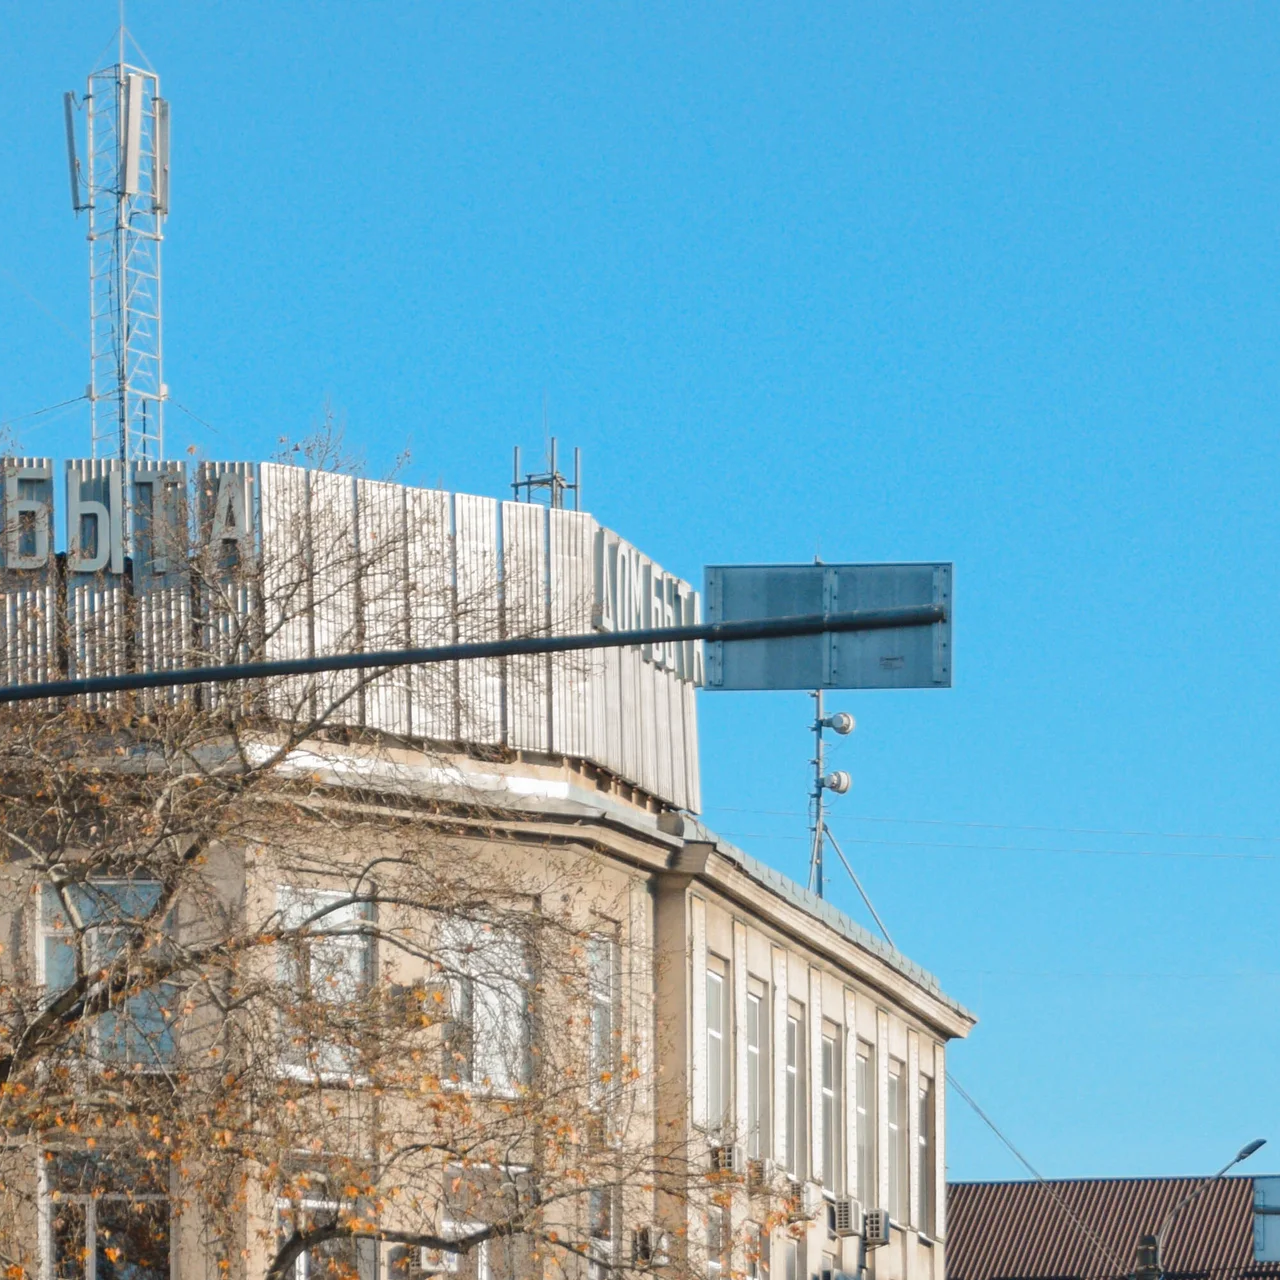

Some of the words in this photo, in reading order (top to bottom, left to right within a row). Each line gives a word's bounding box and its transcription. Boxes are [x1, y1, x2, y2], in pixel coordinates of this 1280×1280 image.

[6, 467, 258, 576] БЫТА
[596, 528, 646, 652] ДОМ
[650, 559, 705, 688] БЫТА
